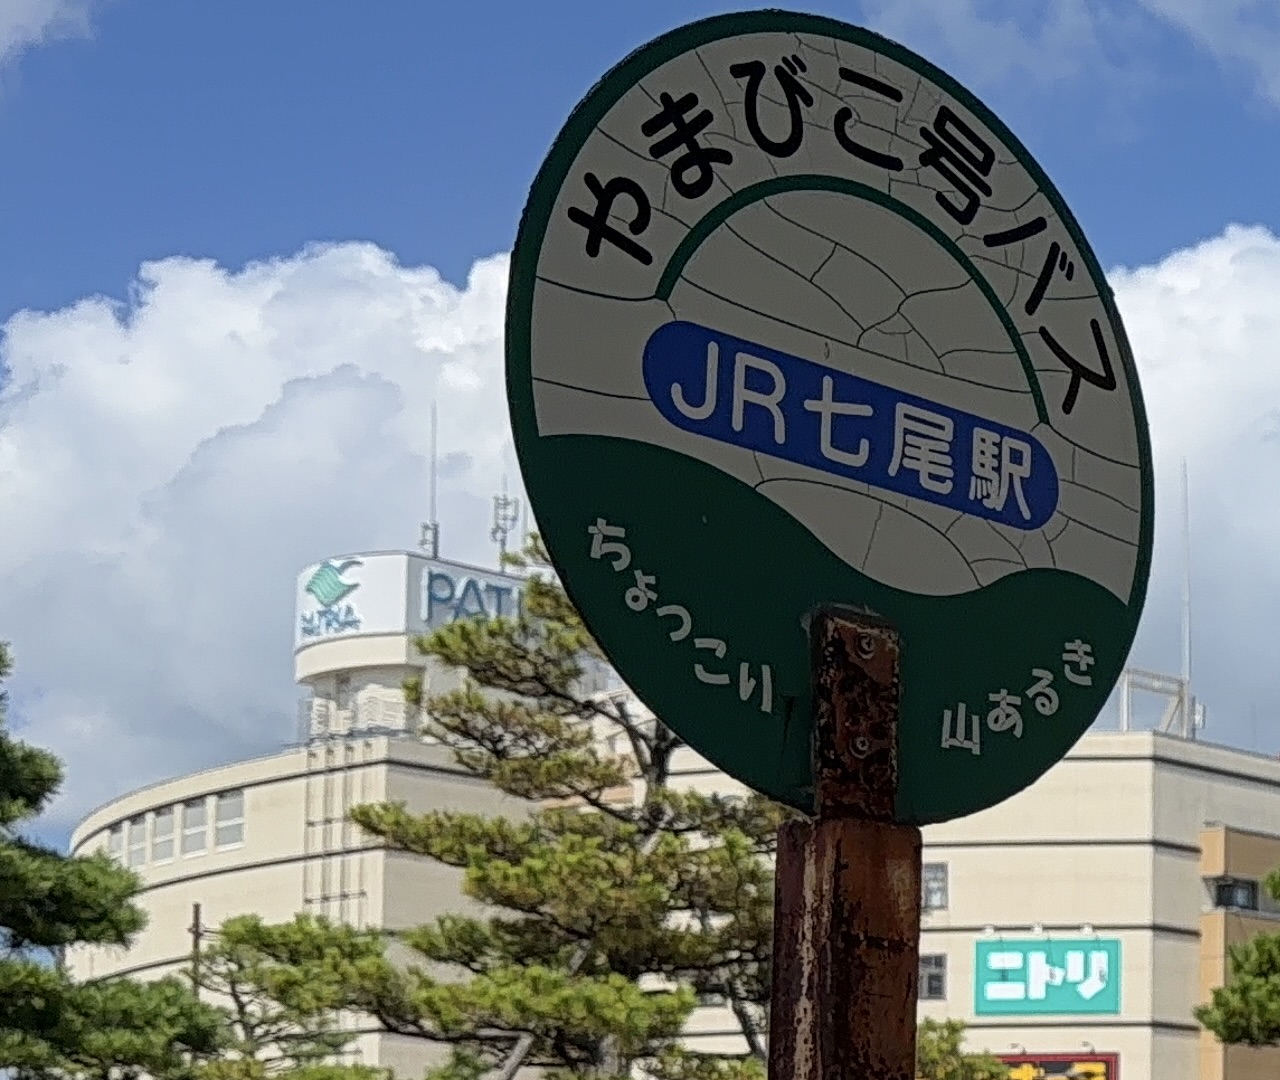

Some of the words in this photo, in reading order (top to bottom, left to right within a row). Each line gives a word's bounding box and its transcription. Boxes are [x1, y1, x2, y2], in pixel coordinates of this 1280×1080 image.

[567, 54, 1117, 415] やまびこ号バス
[670, 341, 1033, 522] JR七尾駅
[588, 517, 773, 714] ちょっこり
[941, 638, 1098, 755] 山あるき
[984, 950, 1109, 1001] ニトリ
